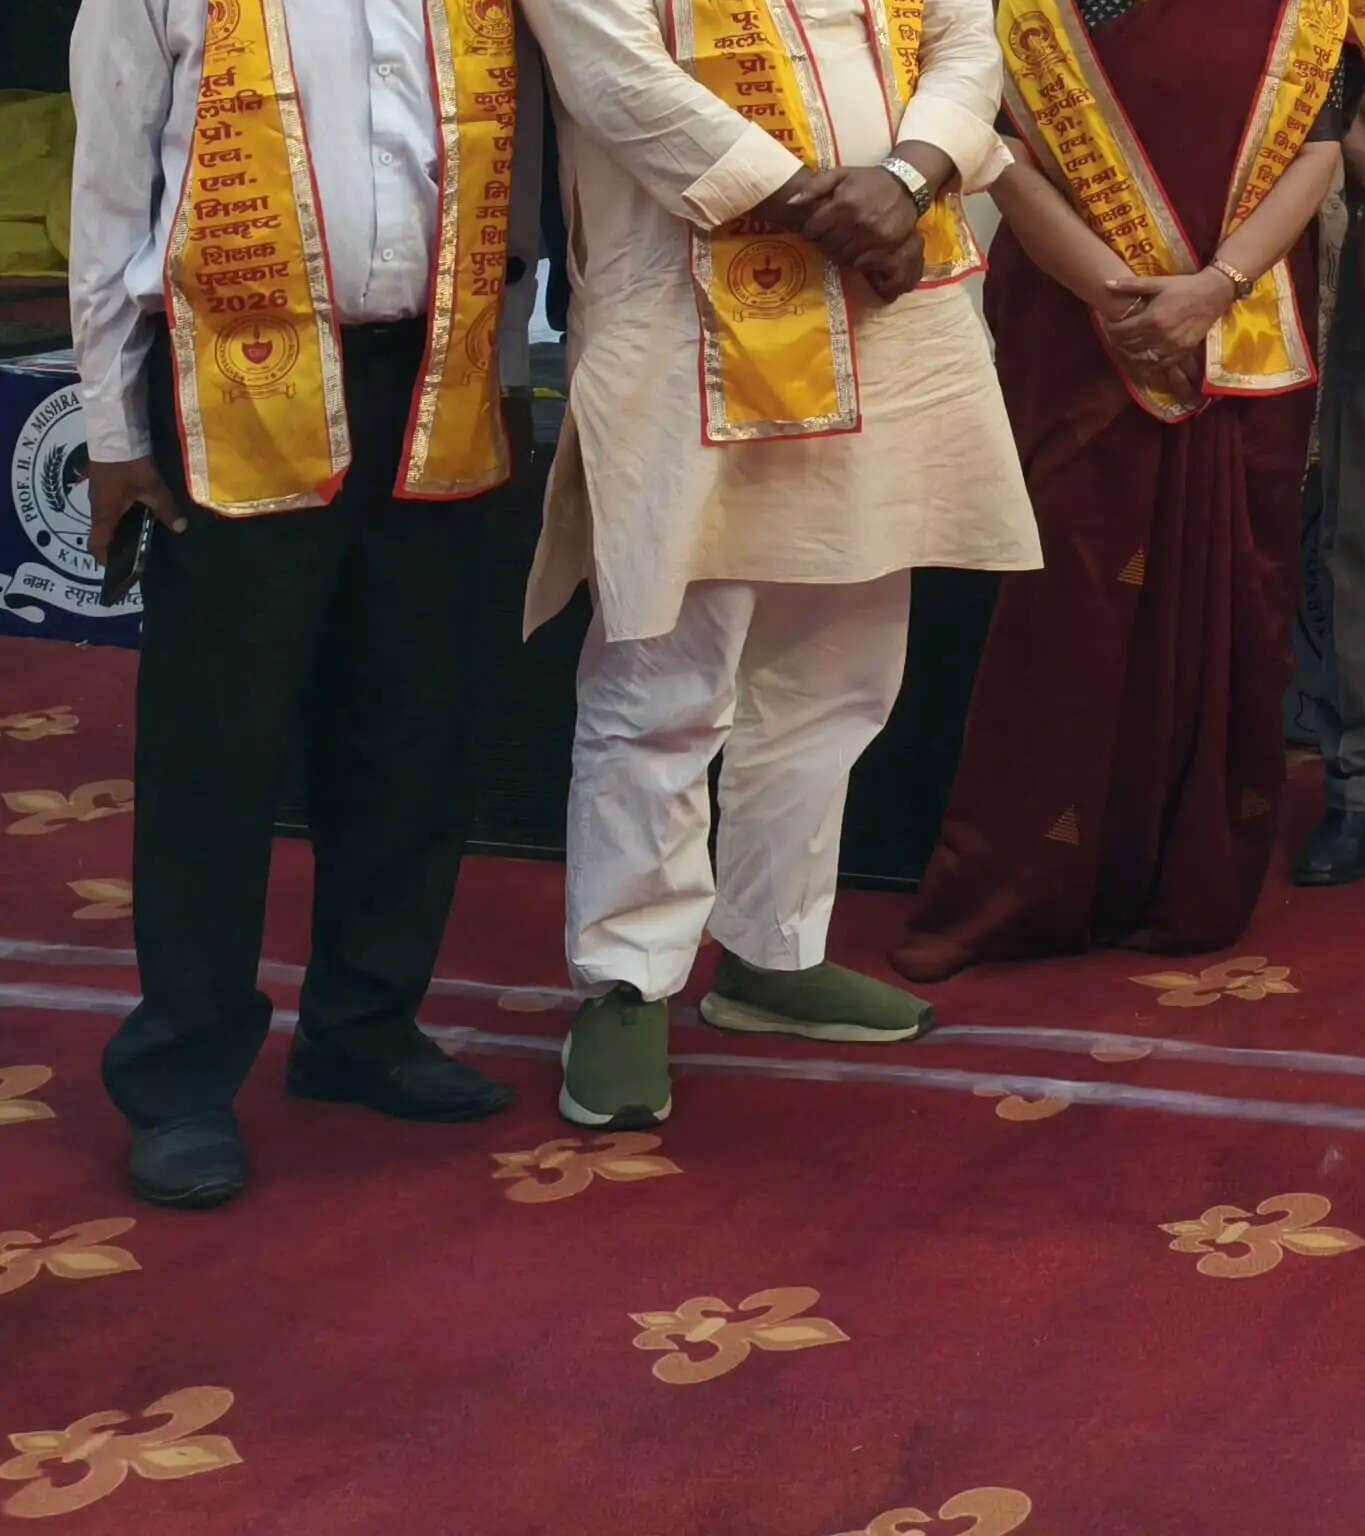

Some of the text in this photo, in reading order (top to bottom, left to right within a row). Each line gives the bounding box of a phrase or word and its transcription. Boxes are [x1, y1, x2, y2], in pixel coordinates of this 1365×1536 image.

[199, 121, 243, 145] प्रो.
[198, 148, 252, 168] एच.
[198, 171, 257, 193] एन.
[194, 194, 269, 220] मिश्रा
[207, 289, 288, 314] 2026
[31, 391, 80, 432] MISHRA
